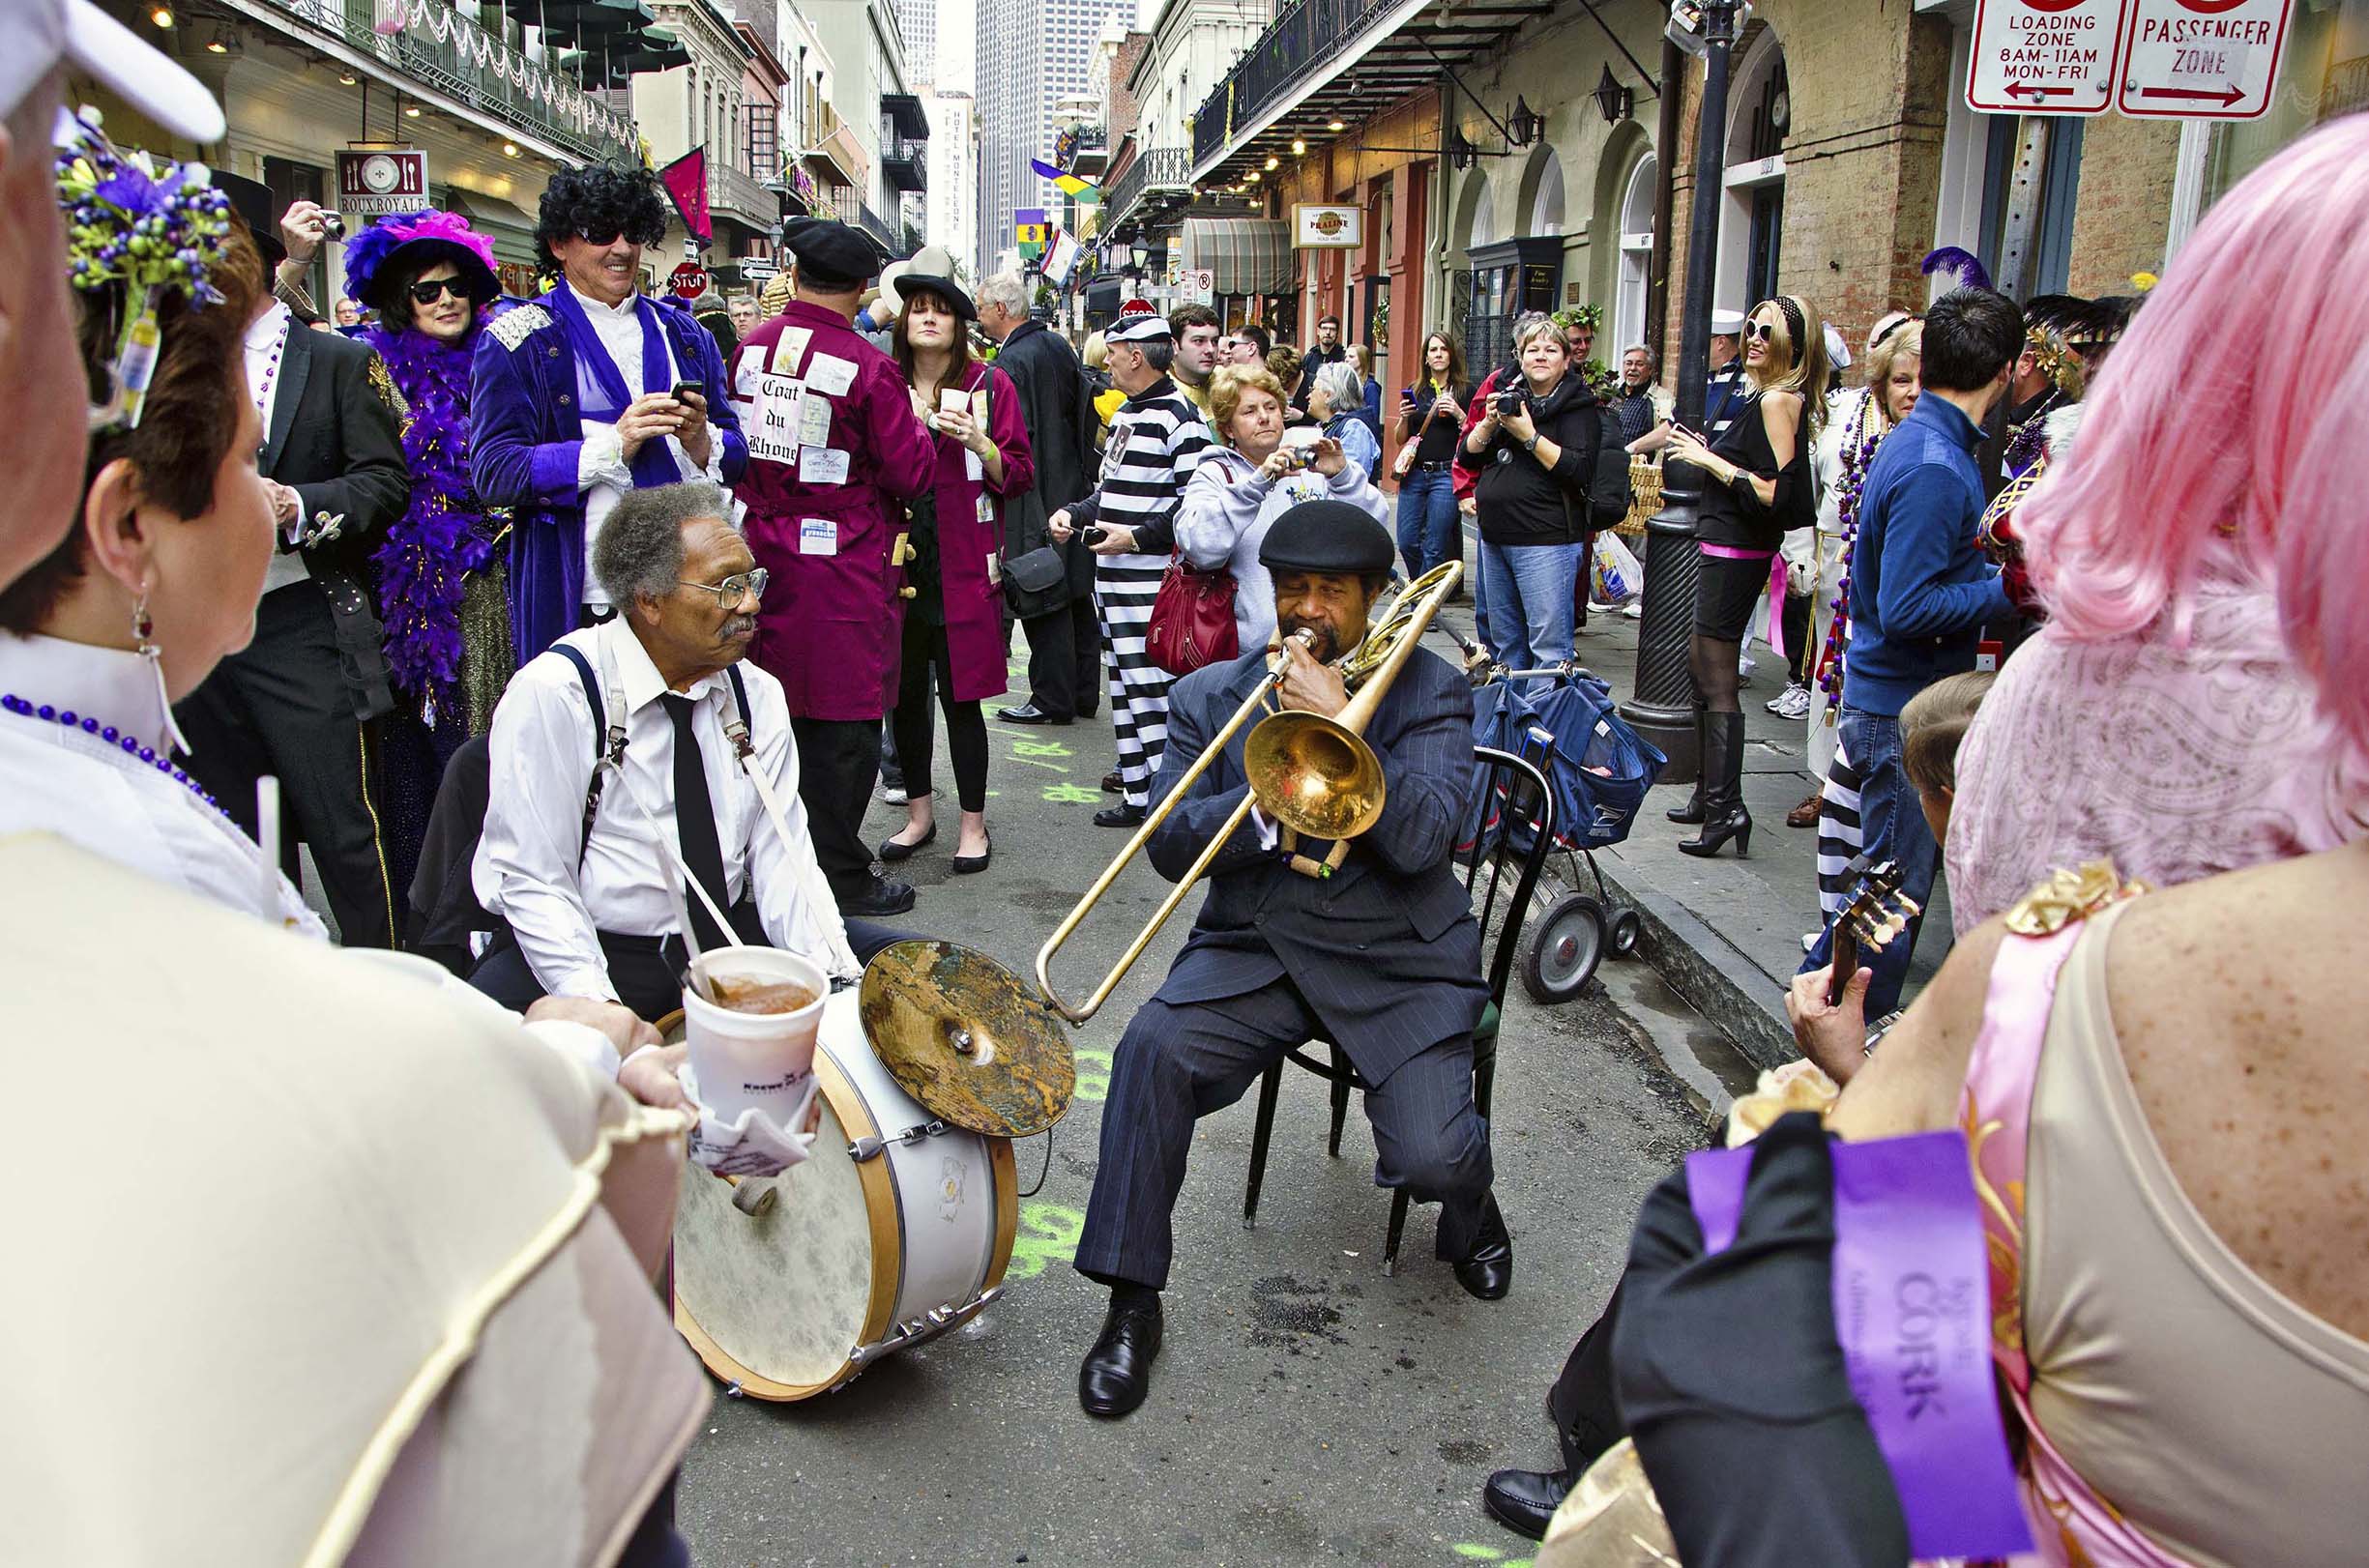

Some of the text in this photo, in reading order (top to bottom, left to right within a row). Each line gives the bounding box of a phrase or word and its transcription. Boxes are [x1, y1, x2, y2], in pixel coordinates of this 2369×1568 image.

[2009, 15, 2095, 30] LOADING
[2142, 18, 2270, 44] PASSENGER
[2024, 32, 2076, 46] ZONE
[2172, 49, 2228, 74] ZONE
[2003, 65, 2089, 79] MON-FRI
[341, 197, 424, 212] ROUX ROYALE
[1310, 219, 1349, 229] PRALINE
[673, 273, 705, 288] STOP
[762, 379, 800, 401] Coat
[766, 409, 785, 429] du
[748, 435, 797, 460] Rhone
[1894, 1271, 1949, 1423] CORK
